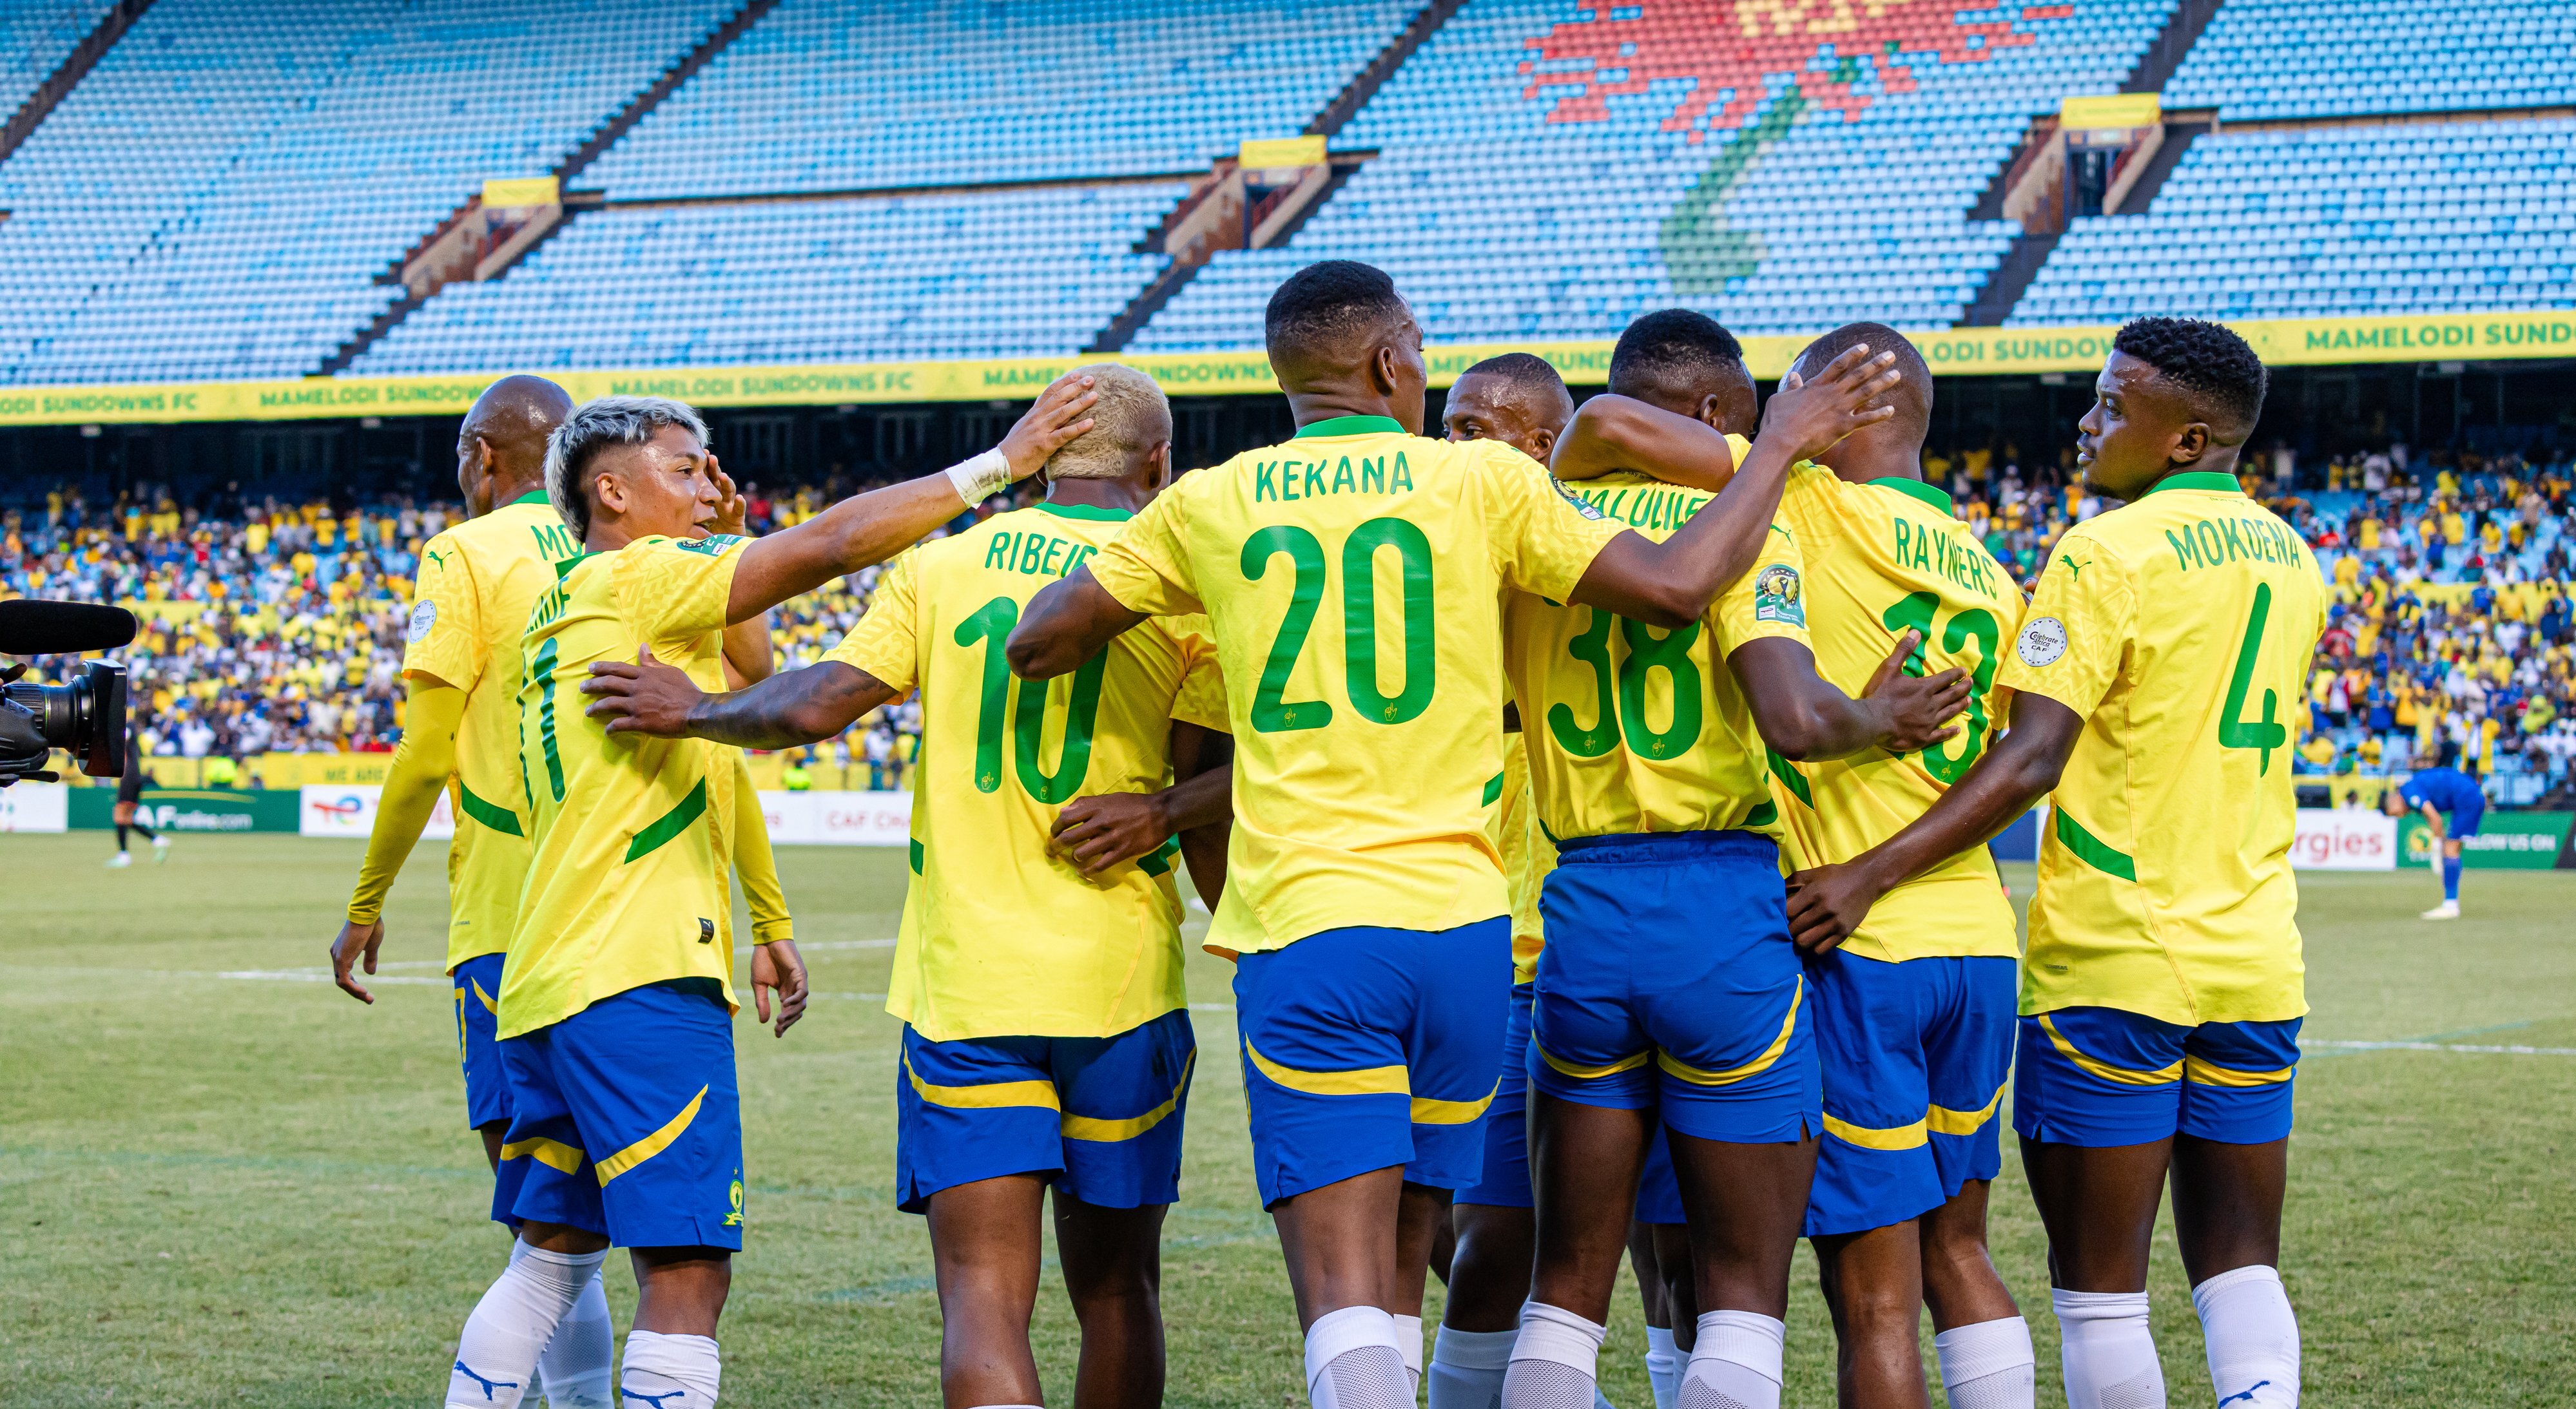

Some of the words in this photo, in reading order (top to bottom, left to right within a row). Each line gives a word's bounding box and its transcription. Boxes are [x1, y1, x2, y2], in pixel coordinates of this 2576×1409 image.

[2305, 325, 2474, 350] MAMELODI
[2485, 322, 2576, 345] SUND
[43, 393, 166, 413] SUNDOWNS
[171, 392, 197, 411] FC
[259, 387, 378, 407] MAMELODI
[610, 377, 734, 396] MAMELODI
[741, 371, 877, 396] SUNDOWNS
[884, 371, 913, 391] FC
[1255, 451, 1413, 503] KEKANA
[1573, 488, 1709, 531] ALULILE
[1894, 517, 1997, 600] RAYNERS
[2165, 517, 2301, 571] MOKOENA
[1240, 517, 1436, 733] 20
[1768, 597, 1793, 610] CAF
[2029, 631, 2058, 644] Celebrate
[2032, 638, 2051, 647] Africa
[1542, 595, 1703, 761] 38
[2218, 582, 2287, 778] 4
[954, 596, 1109, 805] 10
